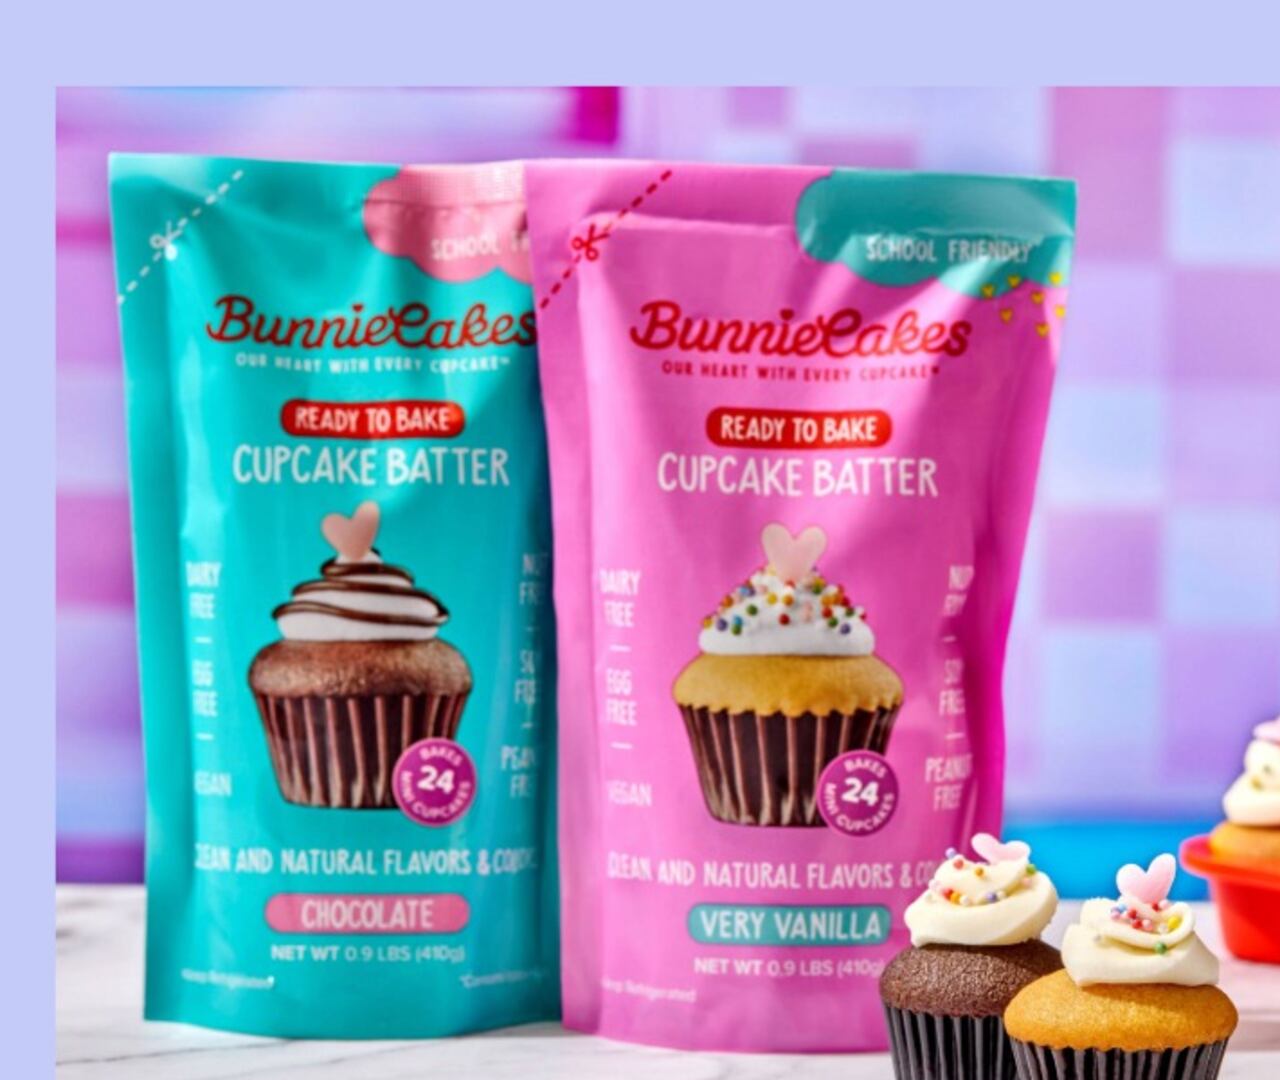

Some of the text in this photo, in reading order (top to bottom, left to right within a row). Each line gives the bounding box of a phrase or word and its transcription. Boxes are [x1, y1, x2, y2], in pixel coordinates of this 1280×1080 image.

[431, 235, 500, 261] SCHOOL
[866, 236, 1031, 264] SCHOOL FRIENDLY
[235, 352, 267, 368] OUR
[275, 355, 321, 373] HEART
[329, 359, 370, 374] WITH
[374, 355, 422, 373] EVERY
[662, 360, 693, 376] OUR
[700, 362, 748, 379] HEART
[757, 366, 797, 382] WITH
[803, 366, 851, 382] EVERY
[295, 405, 450, 432] READY TO BAKE
[720, 414, 878, 443] READY TO BAKE
[232, 444, 511, 487] CUPCAKE BATTER
[657, 451, 939, 498] CUPCAKE BATTER
[604, 601, 634, 628] FREE
[606, 667, 633, 697] EGG
[607, 698, 638, 727] FREE
[419, 745, 464, 767] BAKES
[843, 757, 888, 779] BAKES
[417, 765, 455, 795] 24
[841, 777, 879, 807] 24
[411, 780, 472, 820] CUPCAKES
[824, 782, 895, 832] MINI CUPCAKES
[235, 847, 274, 874] AND
[281, 848, 377, 876] NATURAL
[383, 848, 472, 876] FLAVORS
[477, 850, 491, 877] &
[657, 861, 695, 886] AND
[703, 861, 800, 889] NATURAL
[807, 861, 893, 889] FLAVORS
[900, 863, 913, 889] &
[301, 899, 434, 930] CHOCOLATE
[699, 911, 882, 940] VERY VANILLA
[271, 944, 466, 964] NET WT 0.9 LBS (410g)
[694, 957, 728, 976] NET
[733, 958, 764, 976] WT
[768, 959, 795, 977] 0.9
[800, 959, 833, 977] LBS
